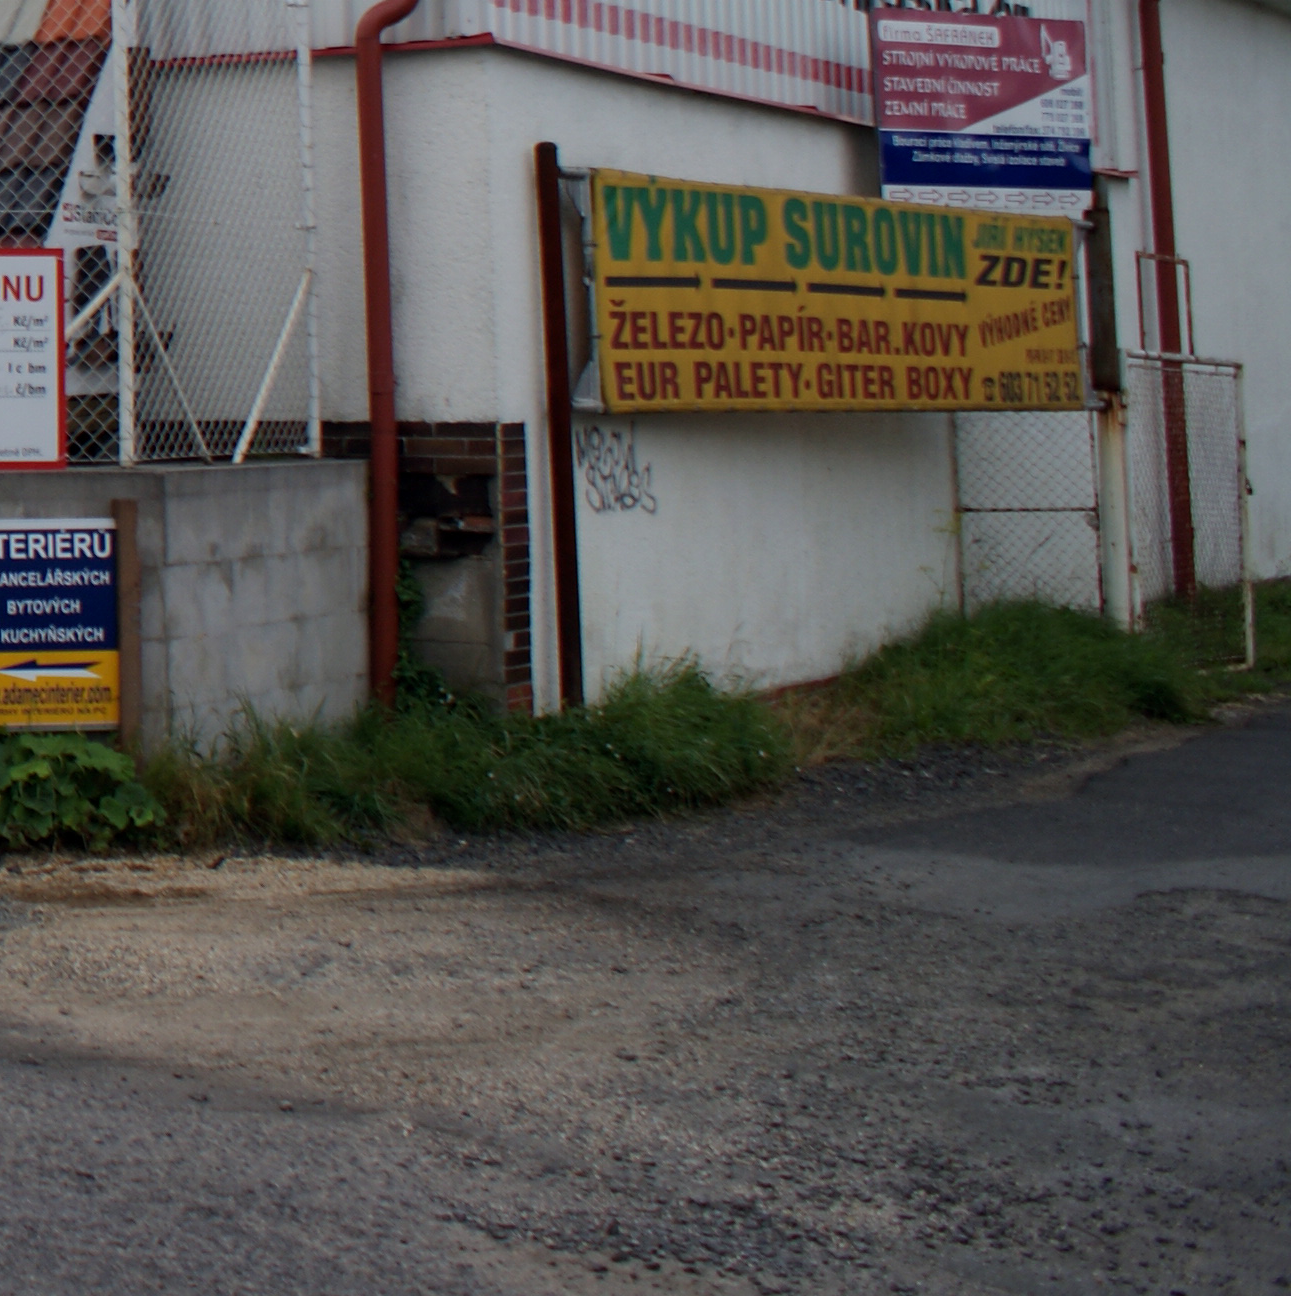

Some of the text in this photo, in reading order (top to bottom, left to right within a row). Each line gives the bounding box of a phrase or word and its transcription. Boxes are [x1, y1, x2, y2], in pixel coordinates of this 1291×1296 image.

[882, 50, 934, 67] STROJNÍ
[1002, 55, 1041, 73] PRÁCE
[883, 76, 946, 94] STAVEBNÍ
[884, 99, 967, 119] ZEMNÍ PRÁCE
[603, 175, 968, 280] VÝKUP SUROVIN
[975, 255, 1068, 290] ZDE!
[977, 296, 1071, 348] VÝHODNÉ CENY
[613, 361, 681, 402] EUR
[908, 366, 974, 402] BOXY
[6, 596, 81, 615] BYTOVÝCH
[0, 624, 105, 644] KUCHYŇSKÝCH
